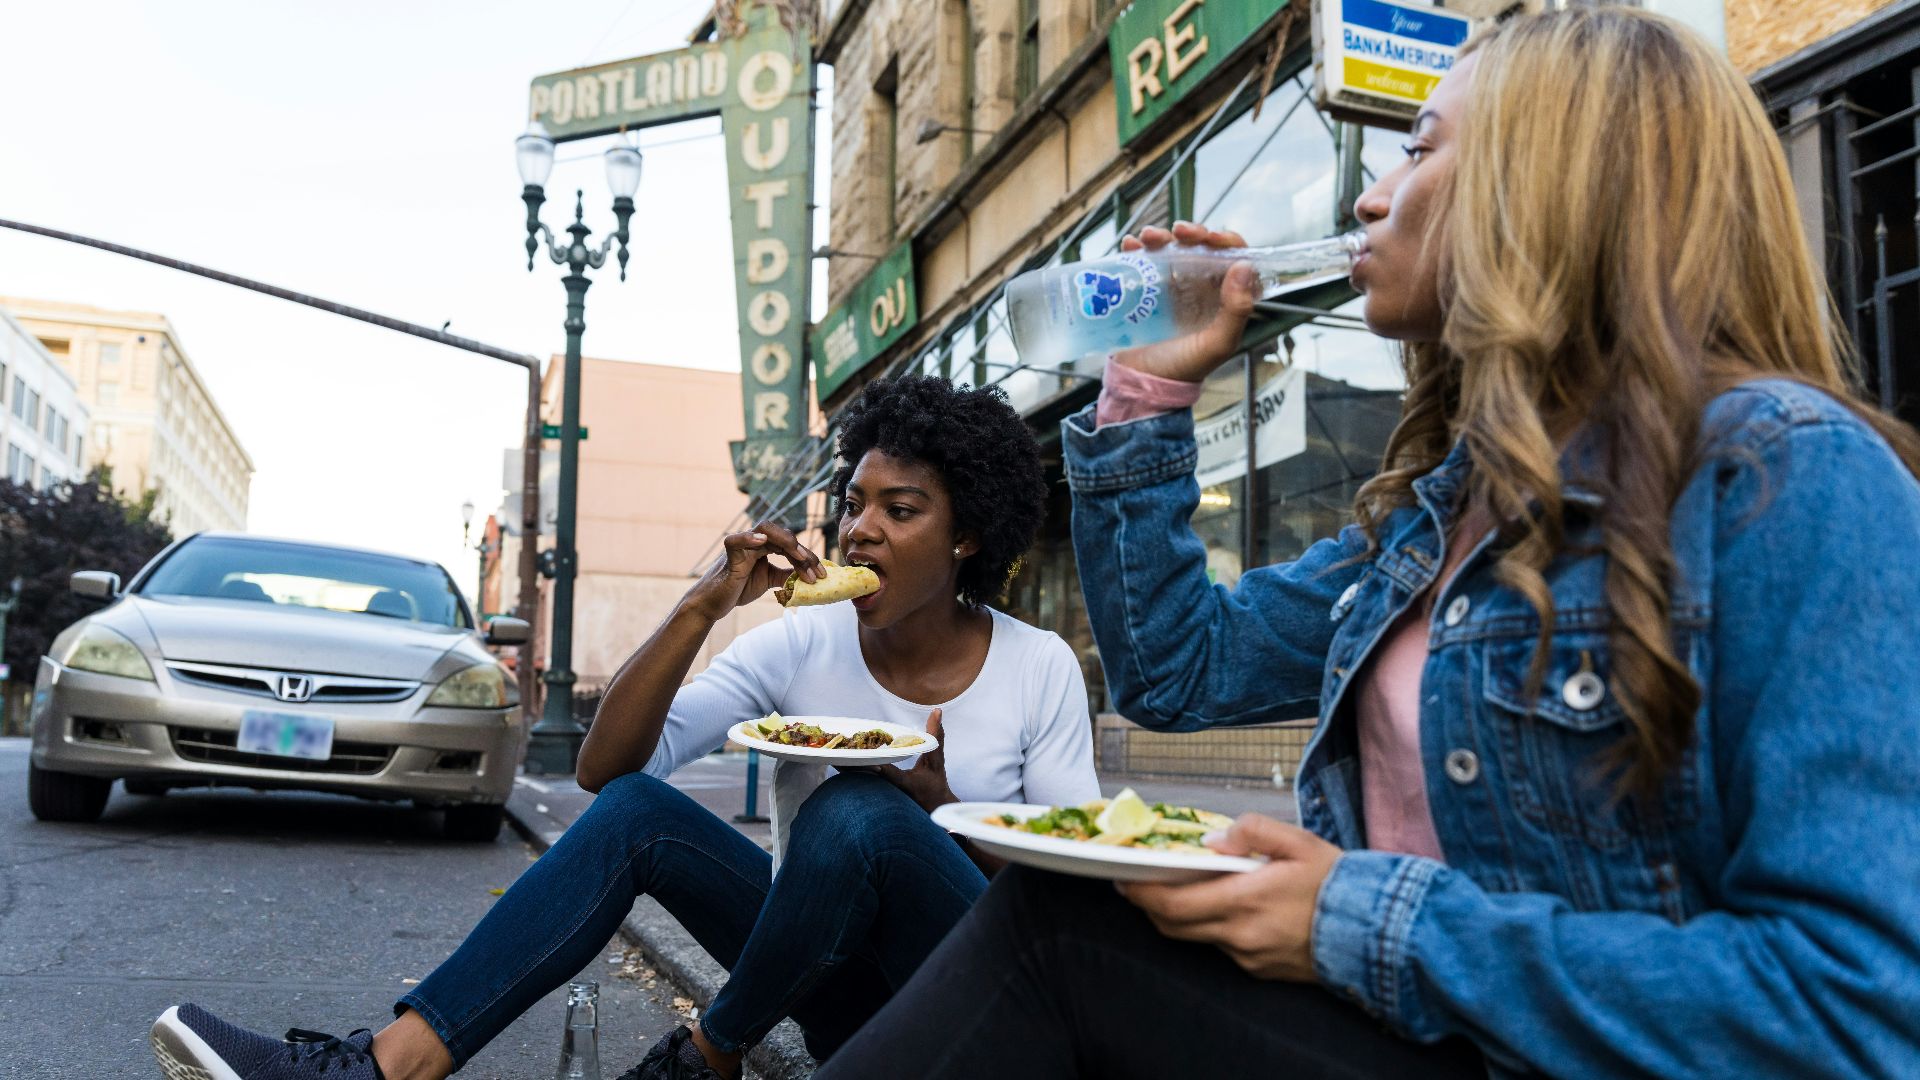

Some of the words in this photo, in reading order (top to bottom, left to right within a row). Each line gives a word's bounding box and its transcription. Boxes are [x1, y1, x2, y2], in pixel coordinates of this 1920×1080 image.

[531, 51, 728, 126] PORTLAND
[1128, 0, 1209, 117] RE
[737, 51, 793, 432] OUTDOOR
